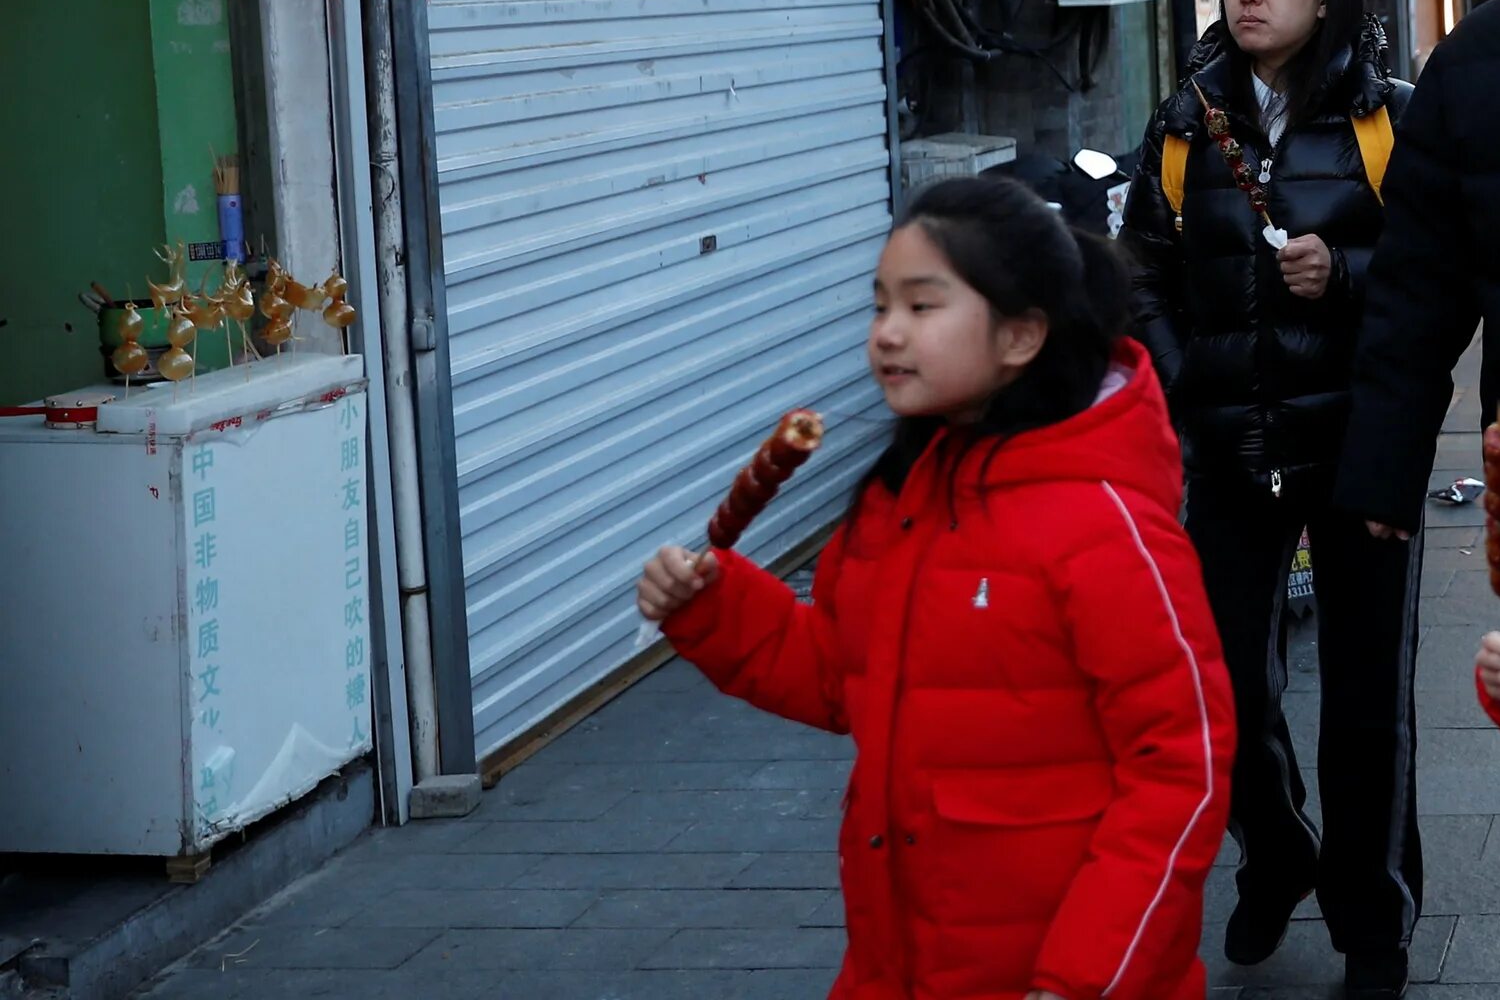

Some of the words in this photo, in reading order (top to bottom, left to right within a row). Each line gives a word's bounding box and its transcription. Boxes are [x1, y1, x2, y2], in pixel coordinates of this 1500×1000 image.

[190, 443, 225, 818] 中国非物质文
[340, 398, 367, 750] 小朋友自己吹的糖人
